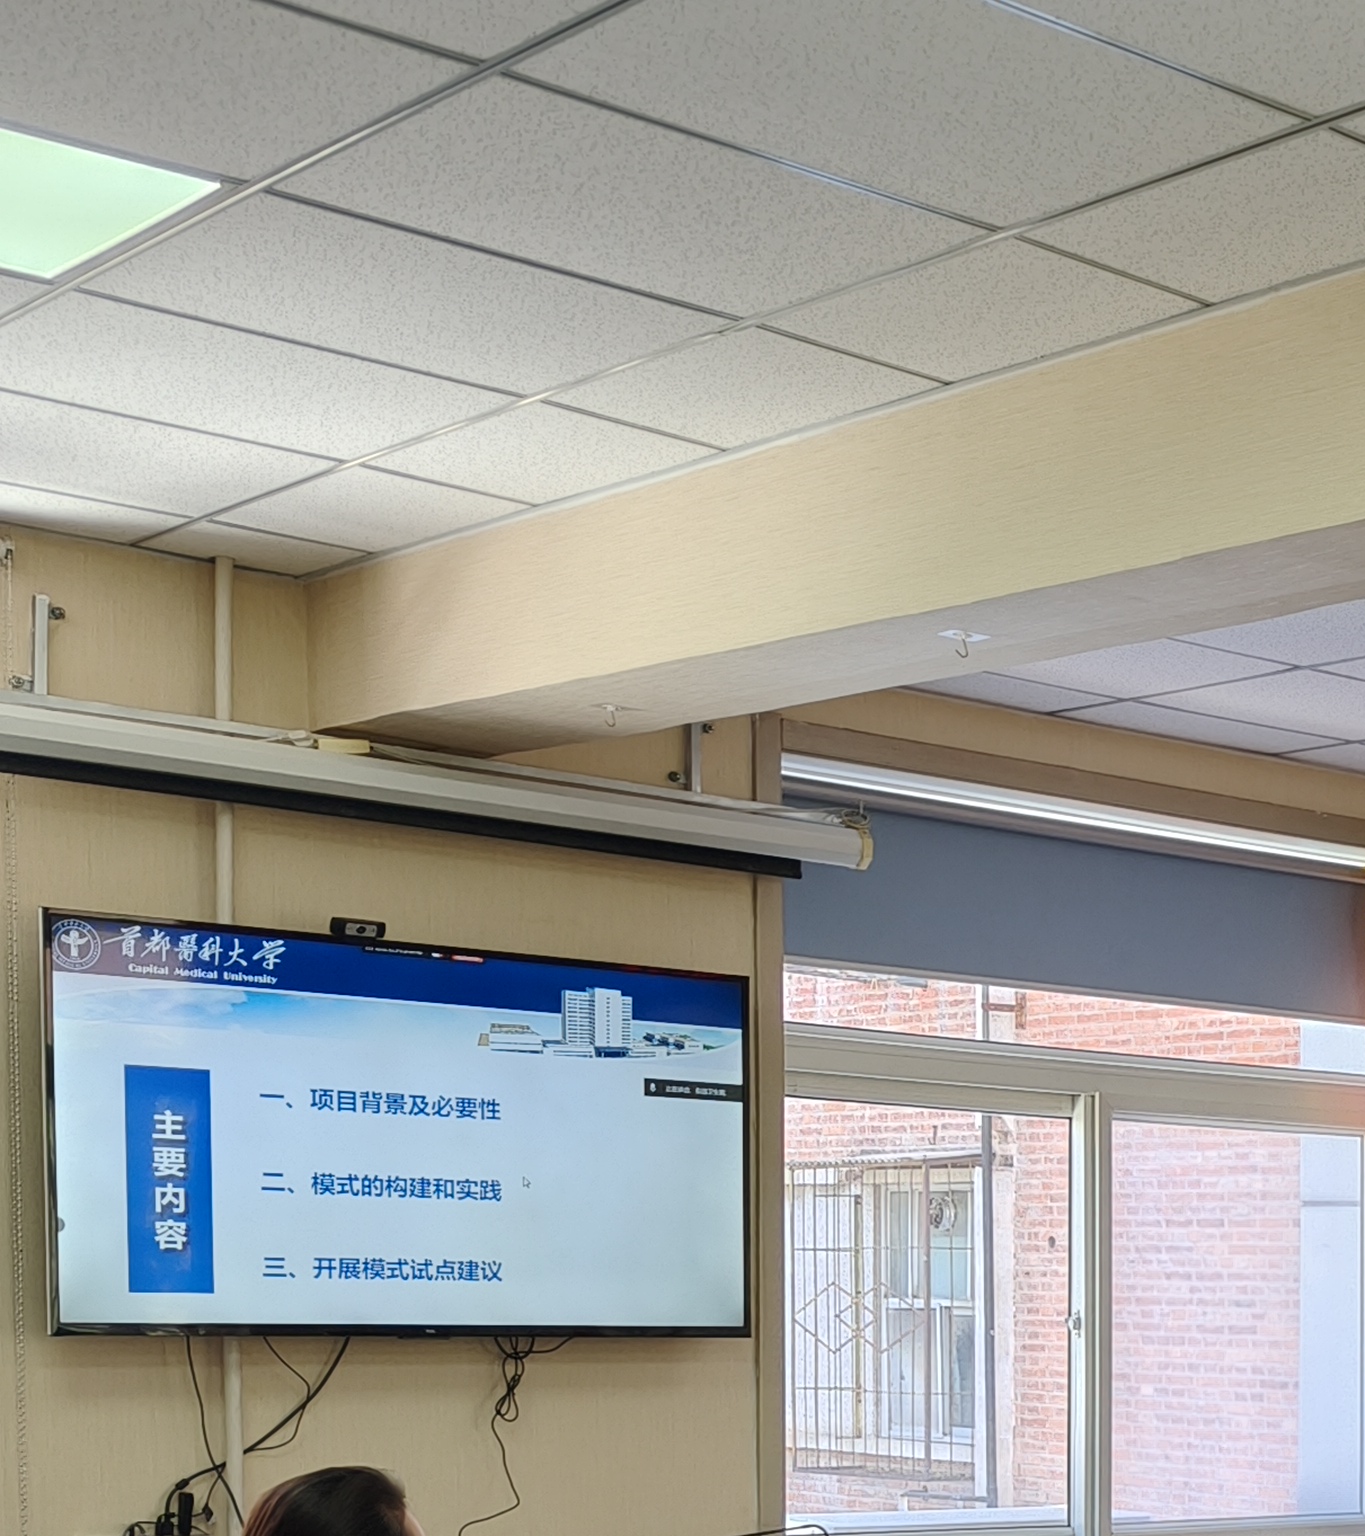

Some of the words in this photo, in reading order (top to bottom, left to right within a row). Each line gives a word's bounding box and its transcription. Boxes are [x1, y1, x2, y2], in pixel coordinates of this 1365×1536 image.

[128, 963, 168, 976] Capital
[173, 967, 217, 980] Medical
[223, 972, 278, 985] University
[259, 1087, 502, 1122] 一、项目背景及必要性
[152, 1109, 188, 1252] 主要内容
[260, 1170, 502, 1203] 二、模式的构建和实践
[262, 1256, 502, 1284] 三、开展模式试点建议
